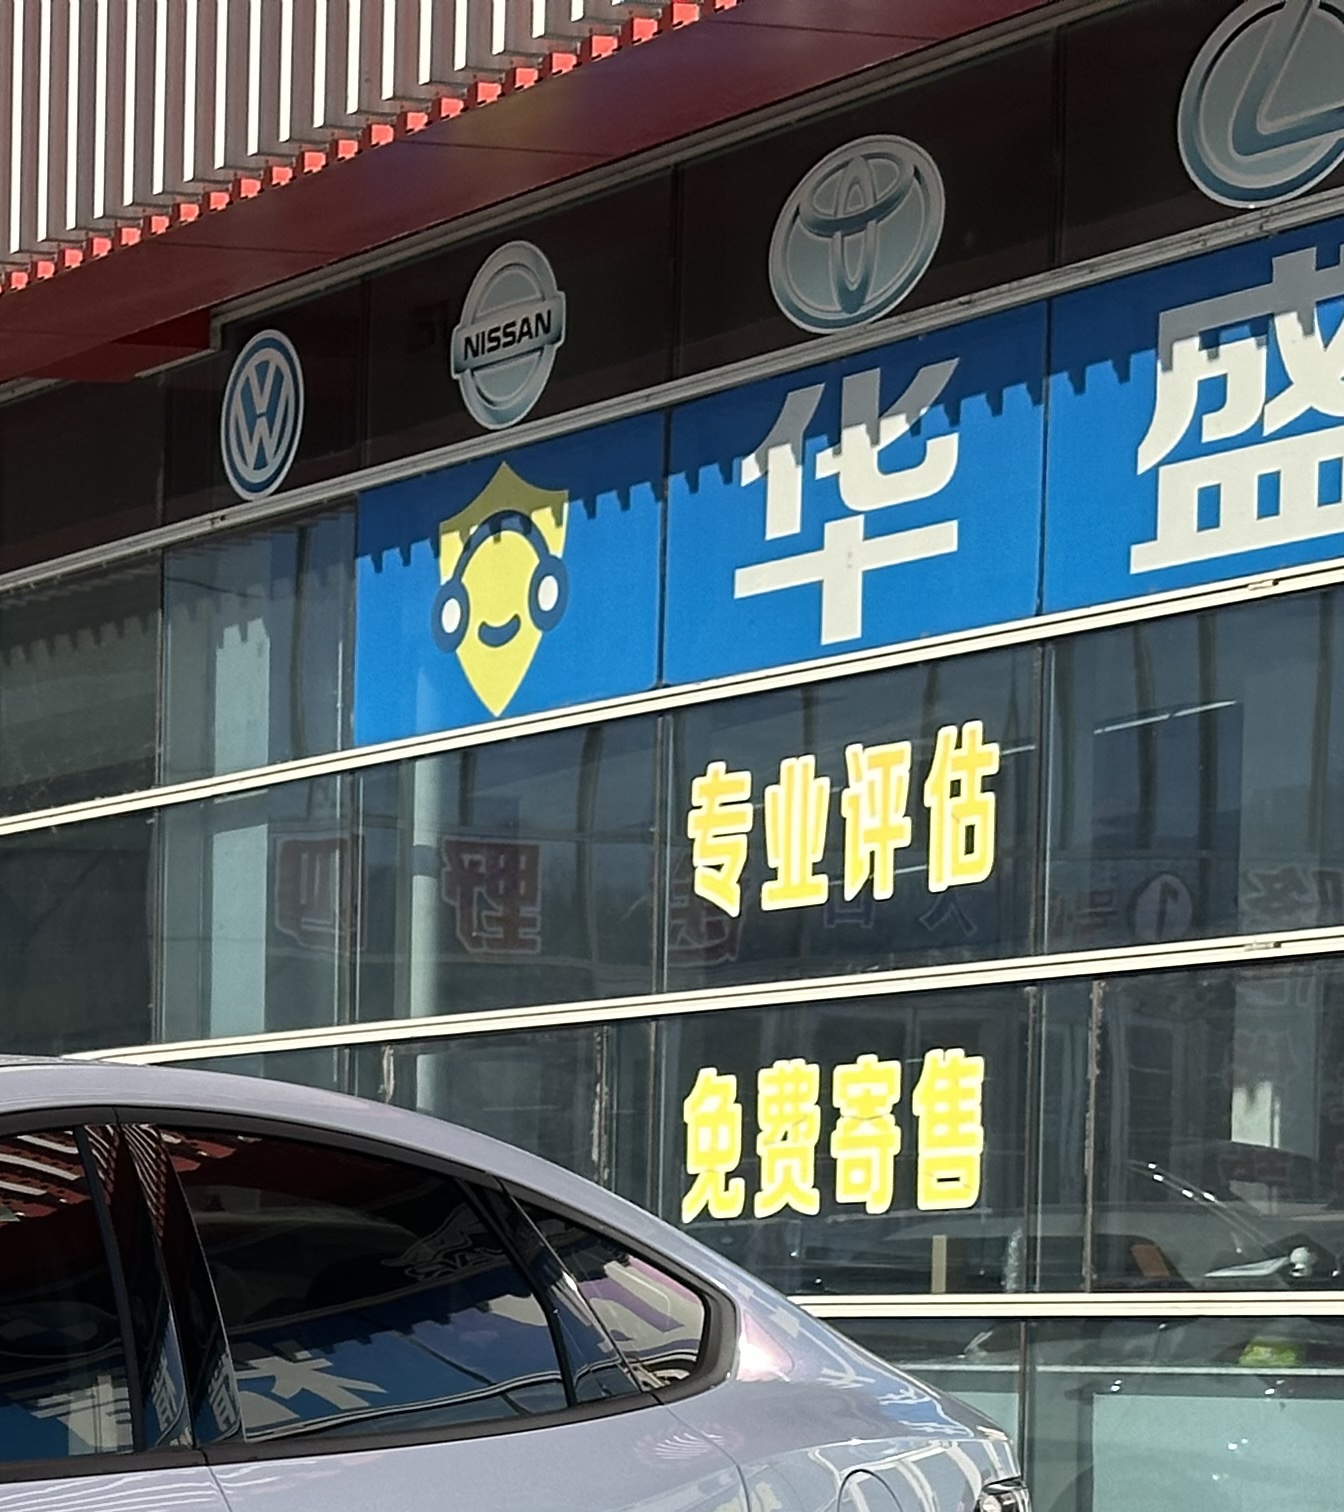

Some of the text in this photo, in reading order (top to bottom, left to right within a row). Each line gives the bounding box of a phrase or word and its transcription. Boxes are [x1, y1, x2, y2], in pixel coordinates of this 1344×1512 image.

[462, 308, 553, 361] NISSAN
[732, 246, 1344, 647] 华盛
[687, 720, 1000, 918] 专业评估
[682, 1048, 985, 1224] 免费寄售
